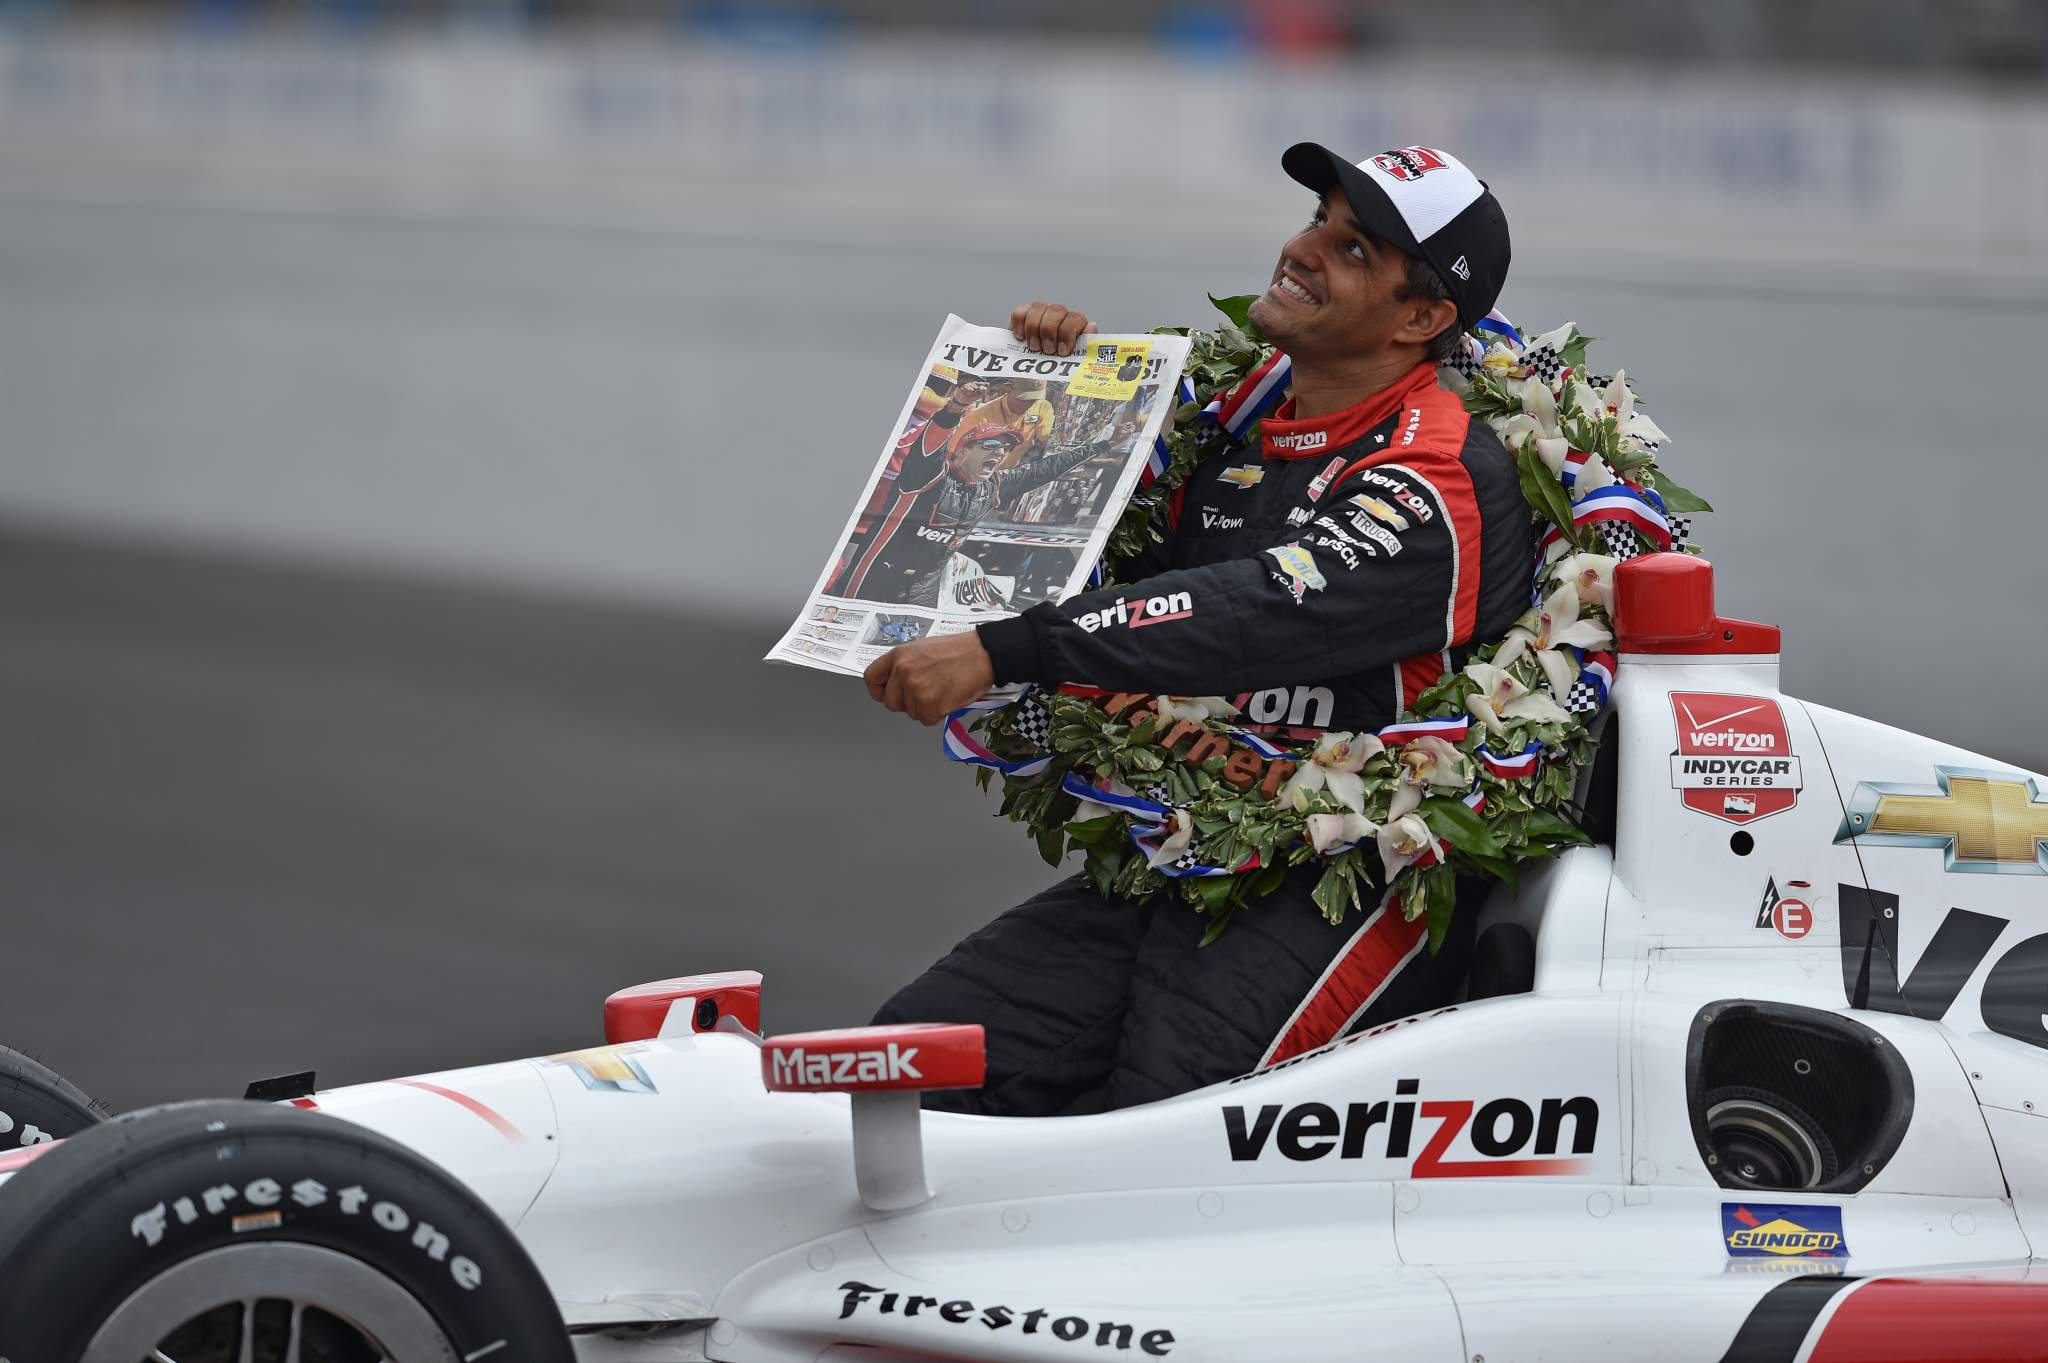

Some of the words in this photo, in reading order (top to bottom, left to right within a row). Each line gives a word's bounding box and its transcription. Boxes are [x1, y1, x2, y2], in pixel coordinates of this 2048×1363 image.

[1012, 358, 1080, 376] GOT
[1272, 430, 1328, 451] verizon
[1362, 470, 1434, 524] verizon
[1353, 514, 1400, 553] TRUCKS
[1072, 591, 1194, 634] erizon
[1690, 728, 1775, 752] verizon
[1683, 760, 1790, 775] INDYCAR
[1703, 776, 1774, 786] SERIES
[1781, 903, 1805, 934] E
[772, 1042, 924, 1086] Mazak
[1222, 1078, 1600, 1179] verizon
[131, 1177, 482, 1291] Firestone
[1733, 1231, 1835, 1248] SUNOCO
[838, 1281, 1176, 1357] Firestone
